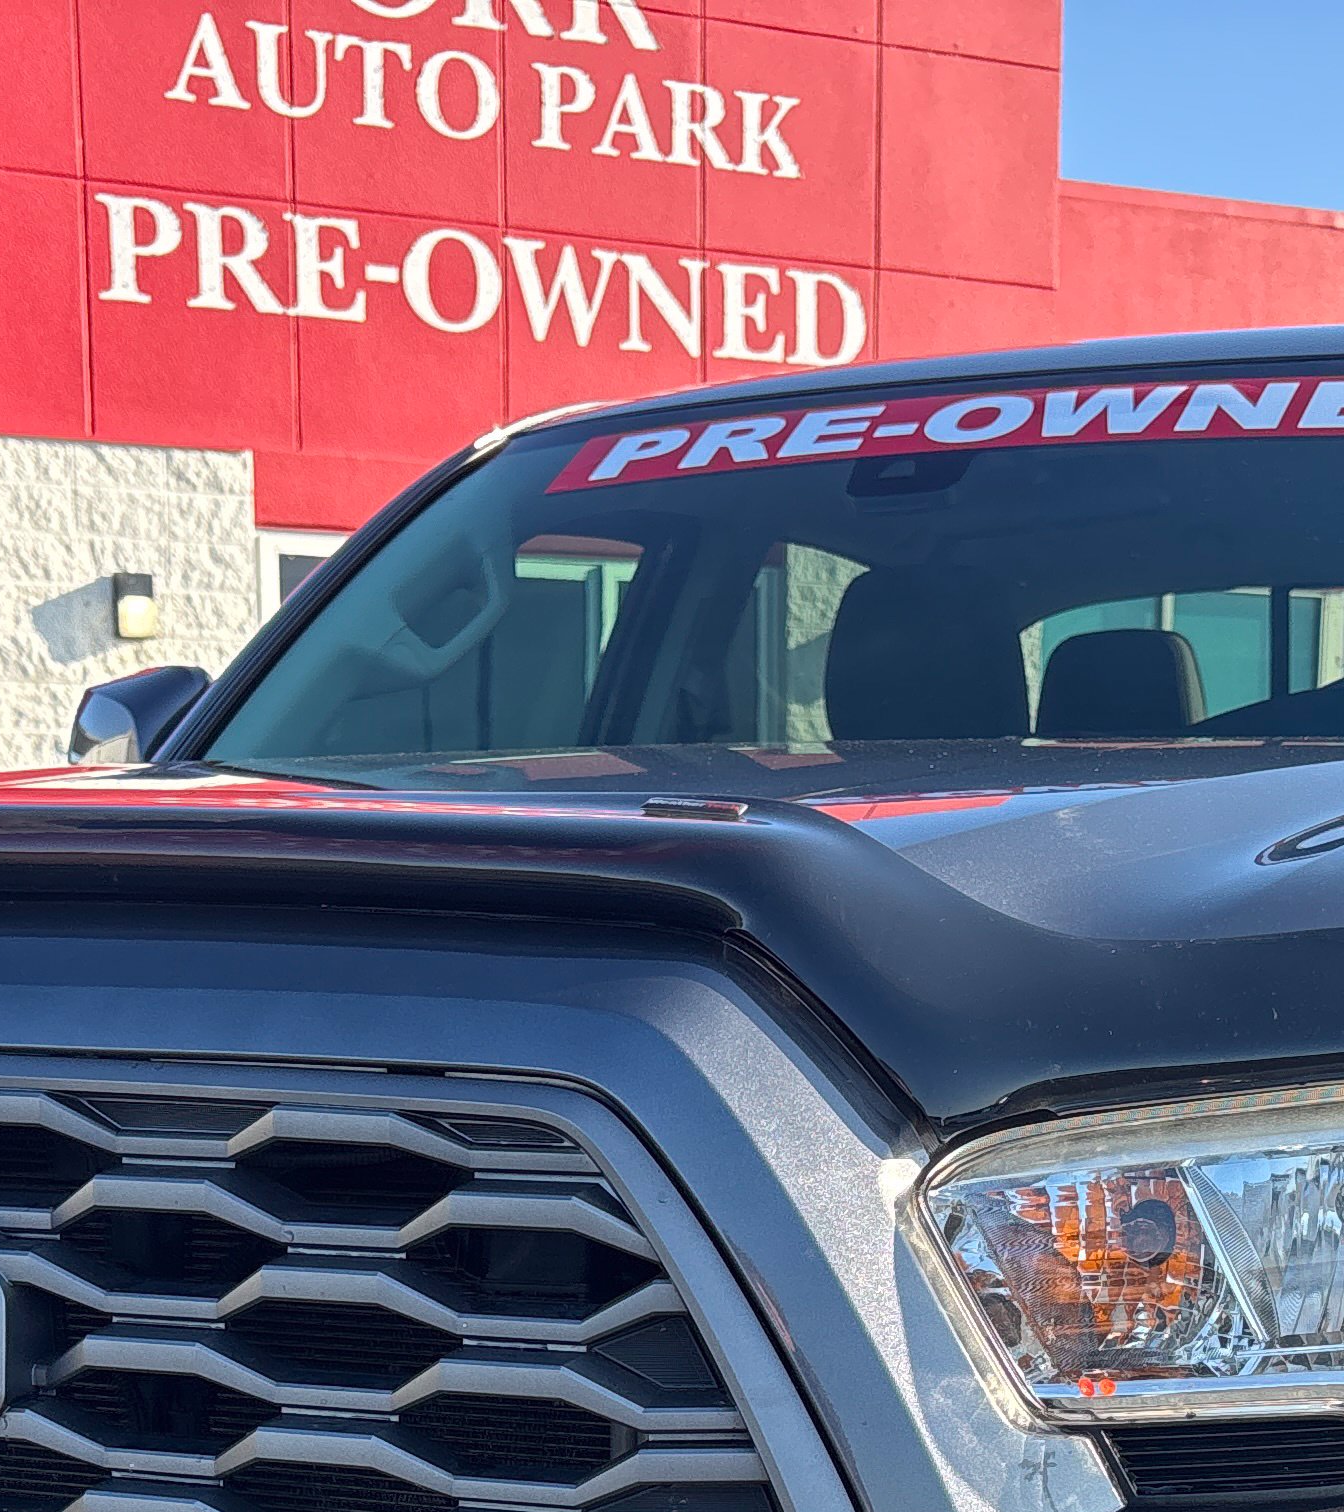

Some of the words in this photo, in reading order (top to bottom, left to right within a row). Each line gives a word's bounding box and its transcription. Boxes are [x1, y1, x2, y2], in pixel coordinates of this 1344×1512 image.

[165, 12, 501, 140] AUTO
[531, 62, 801, 179] PARK
[94, 193, 868, 367] PRE-OWNED
